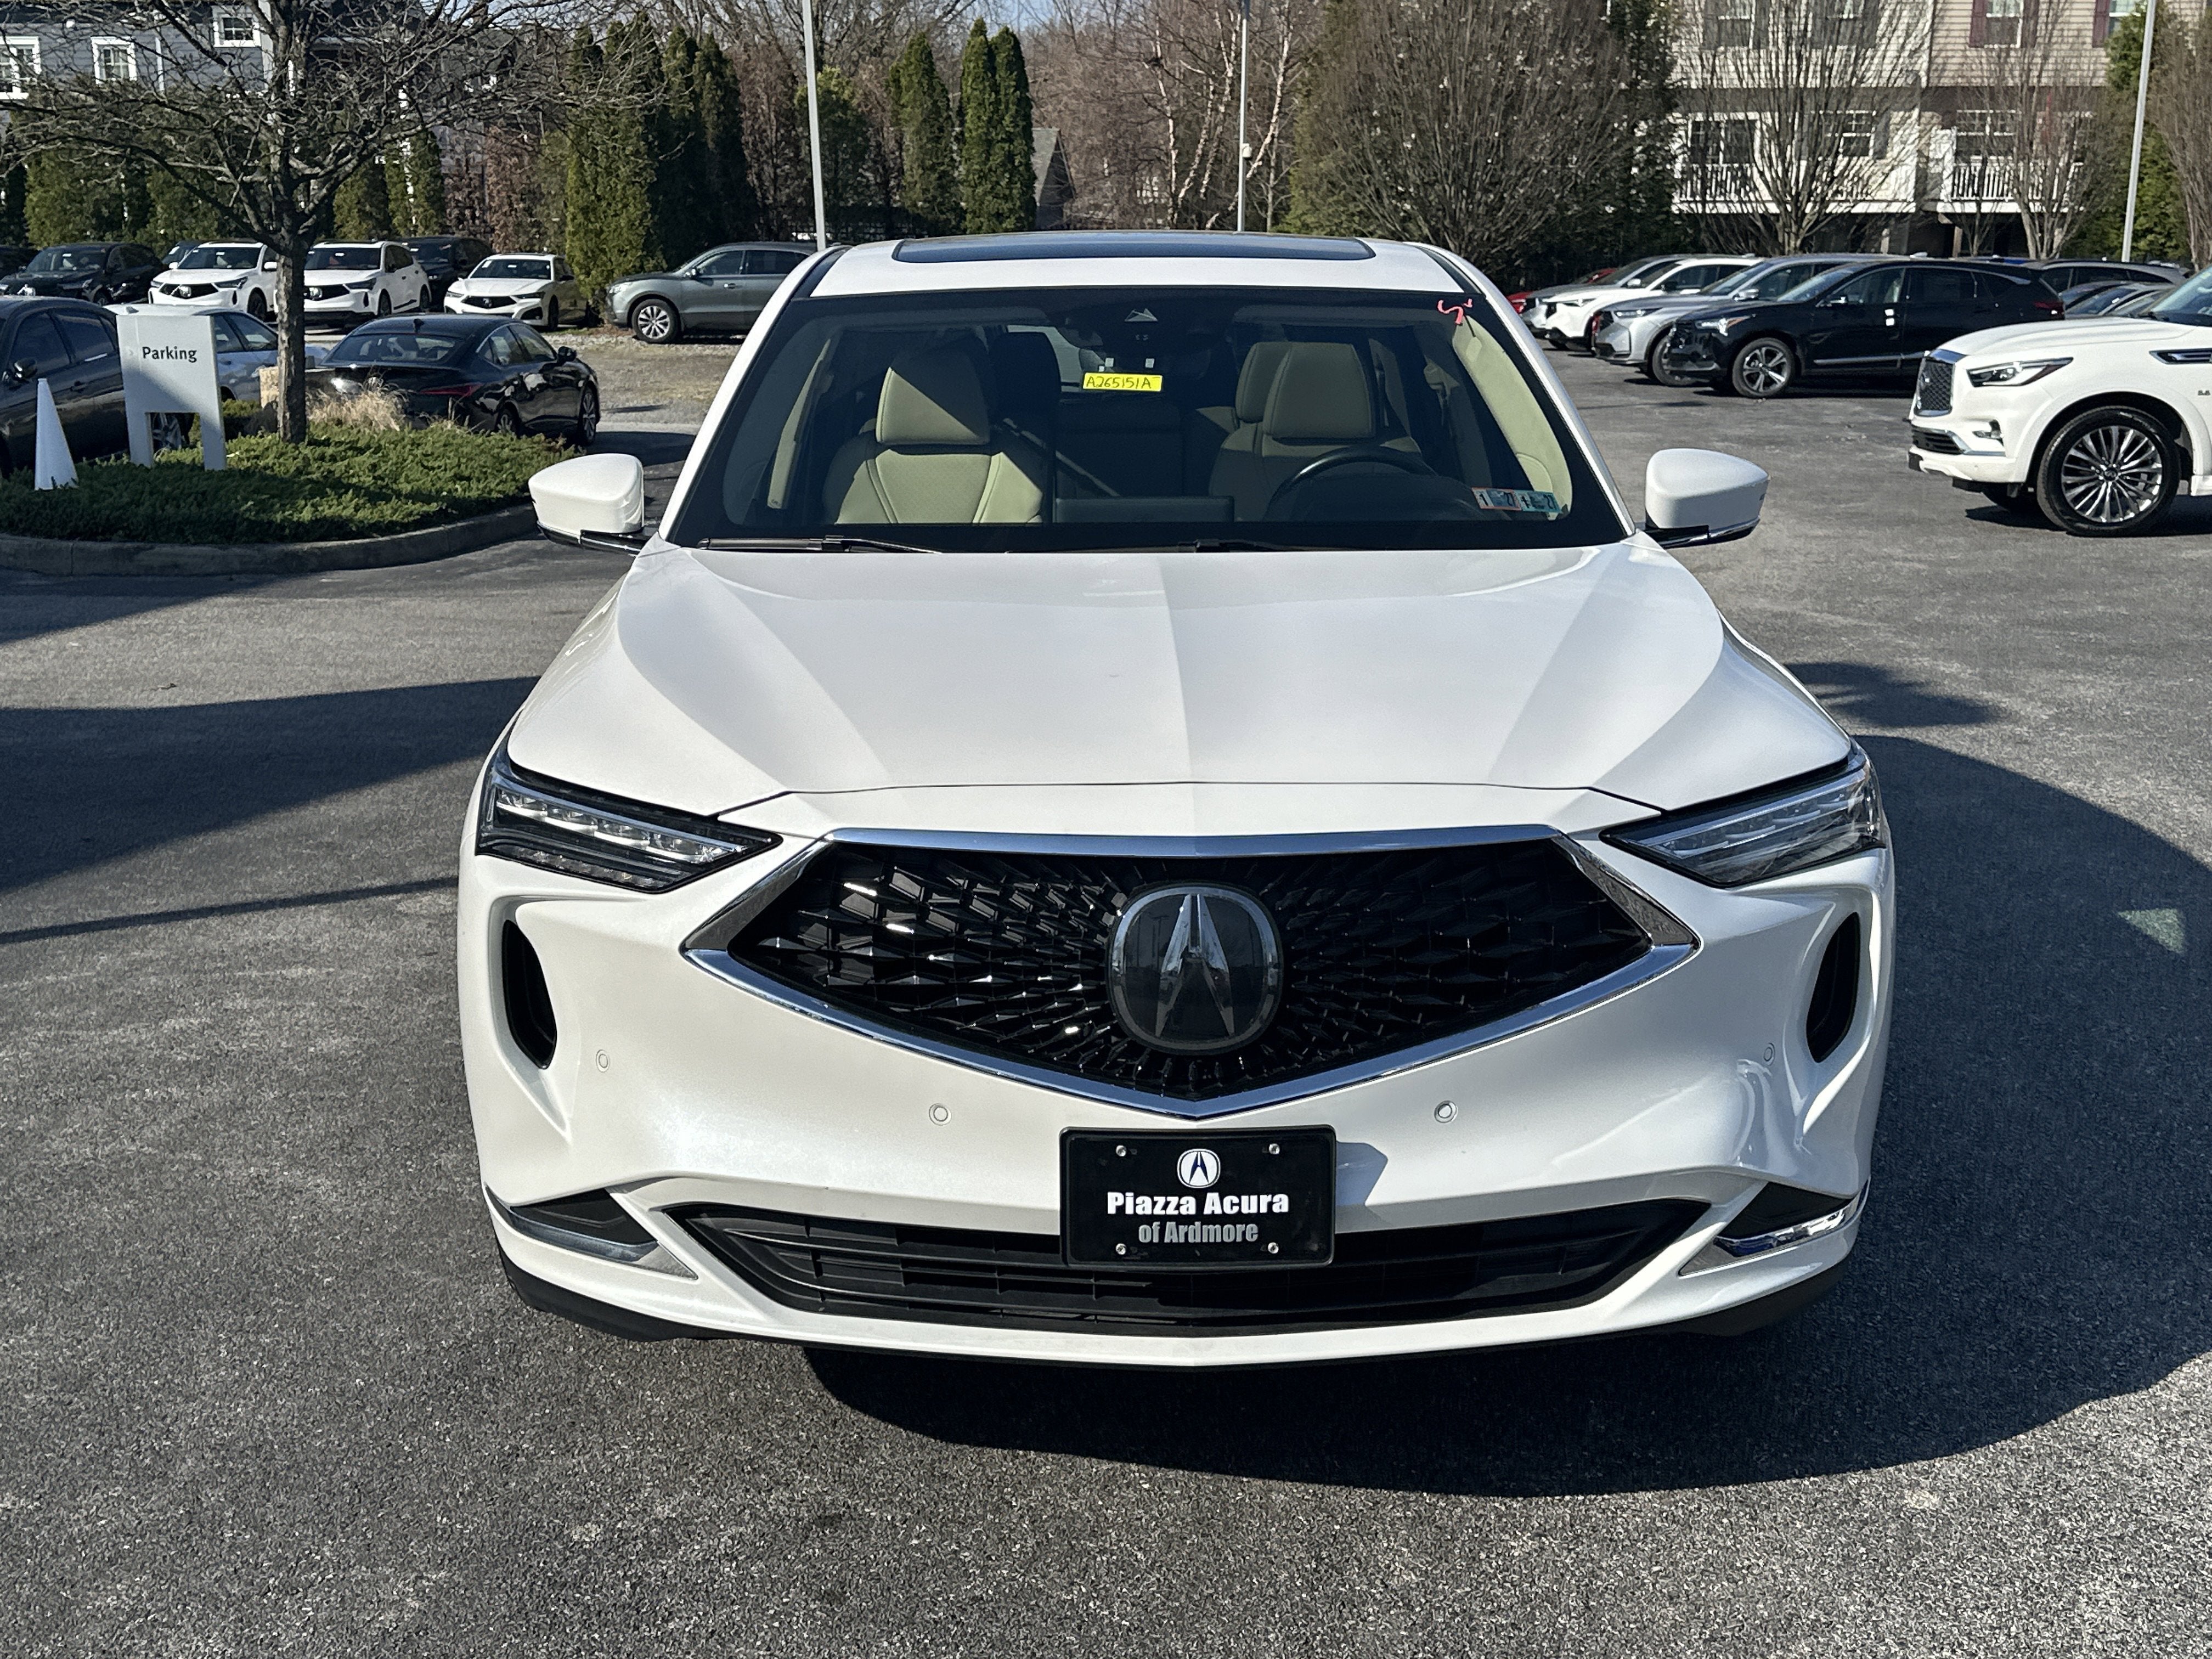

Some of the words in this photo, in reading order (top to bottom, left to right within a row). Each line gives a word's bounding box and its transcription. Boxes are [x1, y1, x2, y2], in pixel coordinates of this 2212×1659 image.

[142, 346, 197, 363] Parking
[1086, 375, 1152, 390] A265151A
[1107, 1191, 1197, 1215] Piazza
[1203, 1192, 1289, 1215] Acura
[1138, 1221, 1160, 1243] of
[1164, 1221, 1259, 1243] Ardmore
